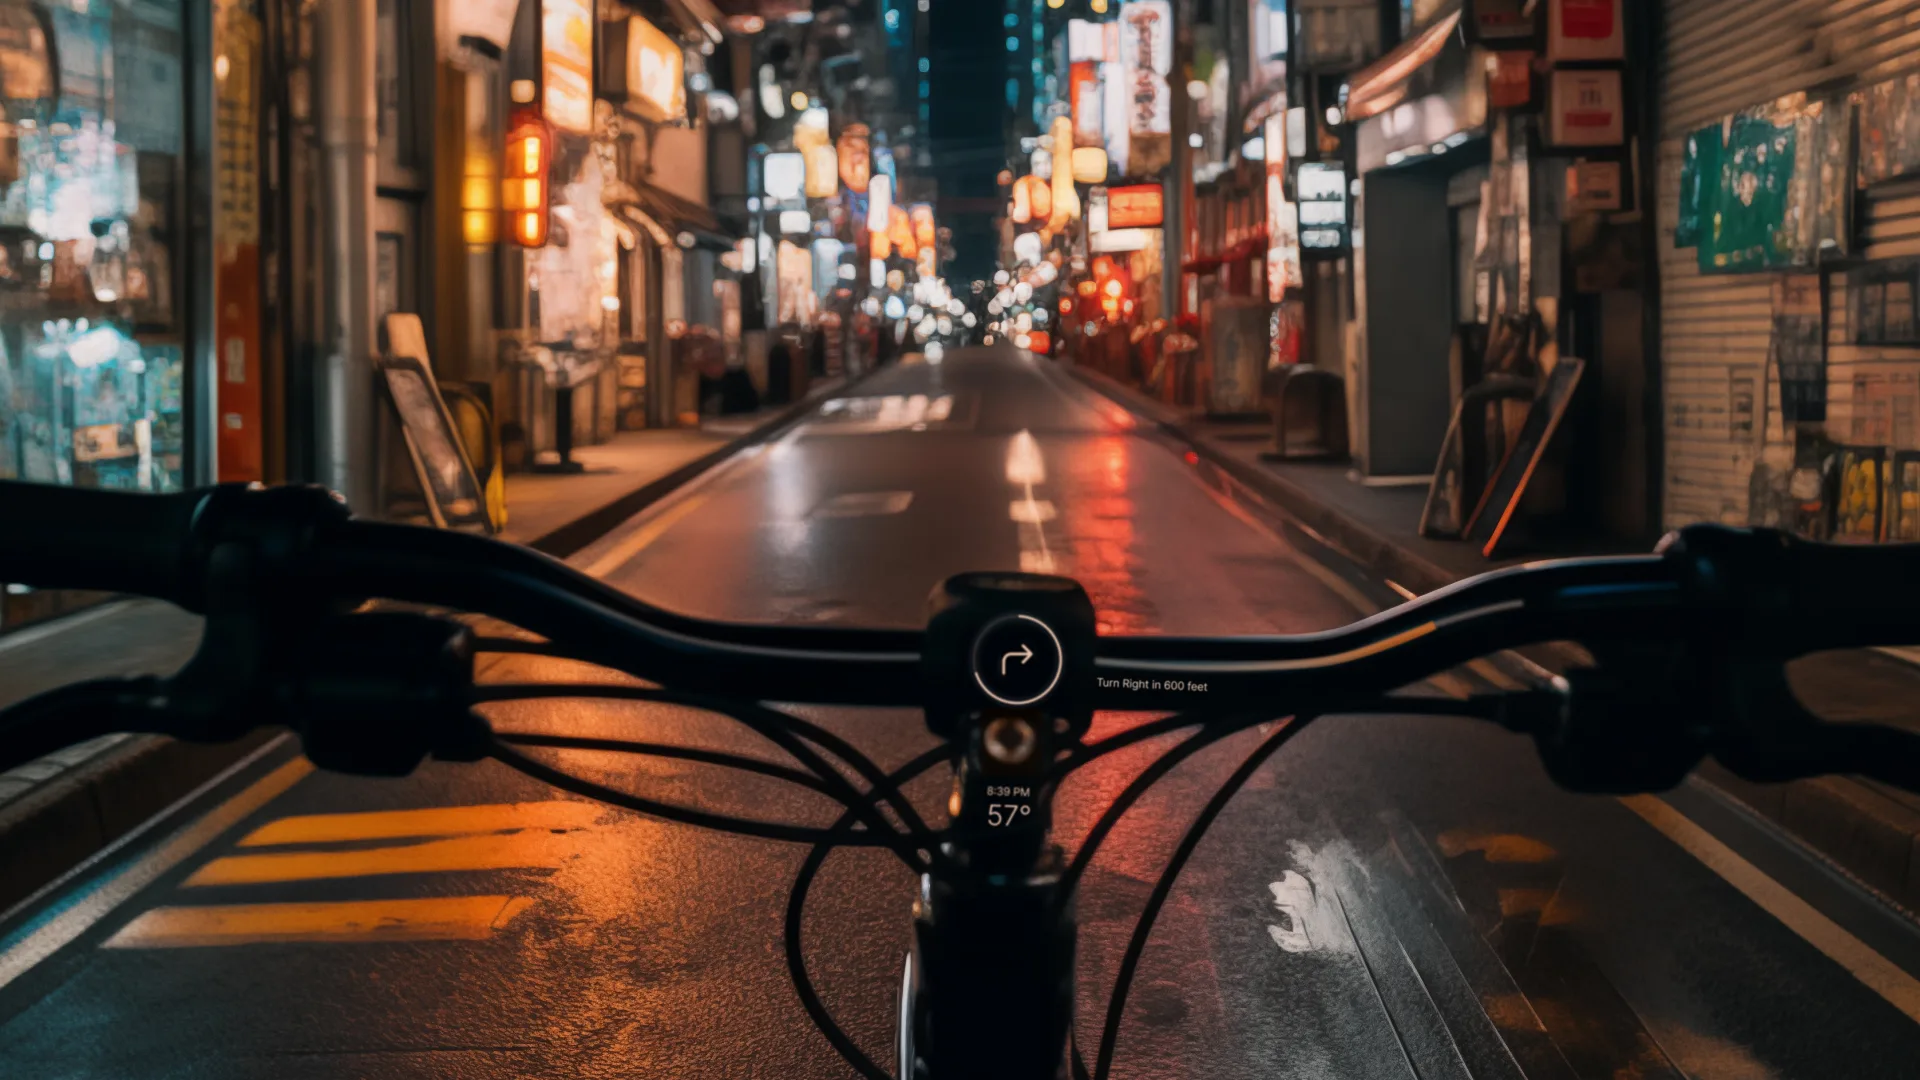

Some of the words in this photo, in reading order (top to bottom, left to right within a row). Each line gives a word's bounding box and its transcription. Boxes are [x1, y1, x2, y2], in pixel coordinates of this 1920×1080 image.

[1096, 677, 1120, 688] Turn
[1122, 678, 1149, 692] Right
[1151, 679, 1161, 690] in
[1163, 680, 1185, 691] 600
[1187, 680, 1208, 692] feet
[986, 786, 1011, 797] 8:39
[1013, 786, 1031, 797] PM
[987, 803, 1031, 827] 57°
